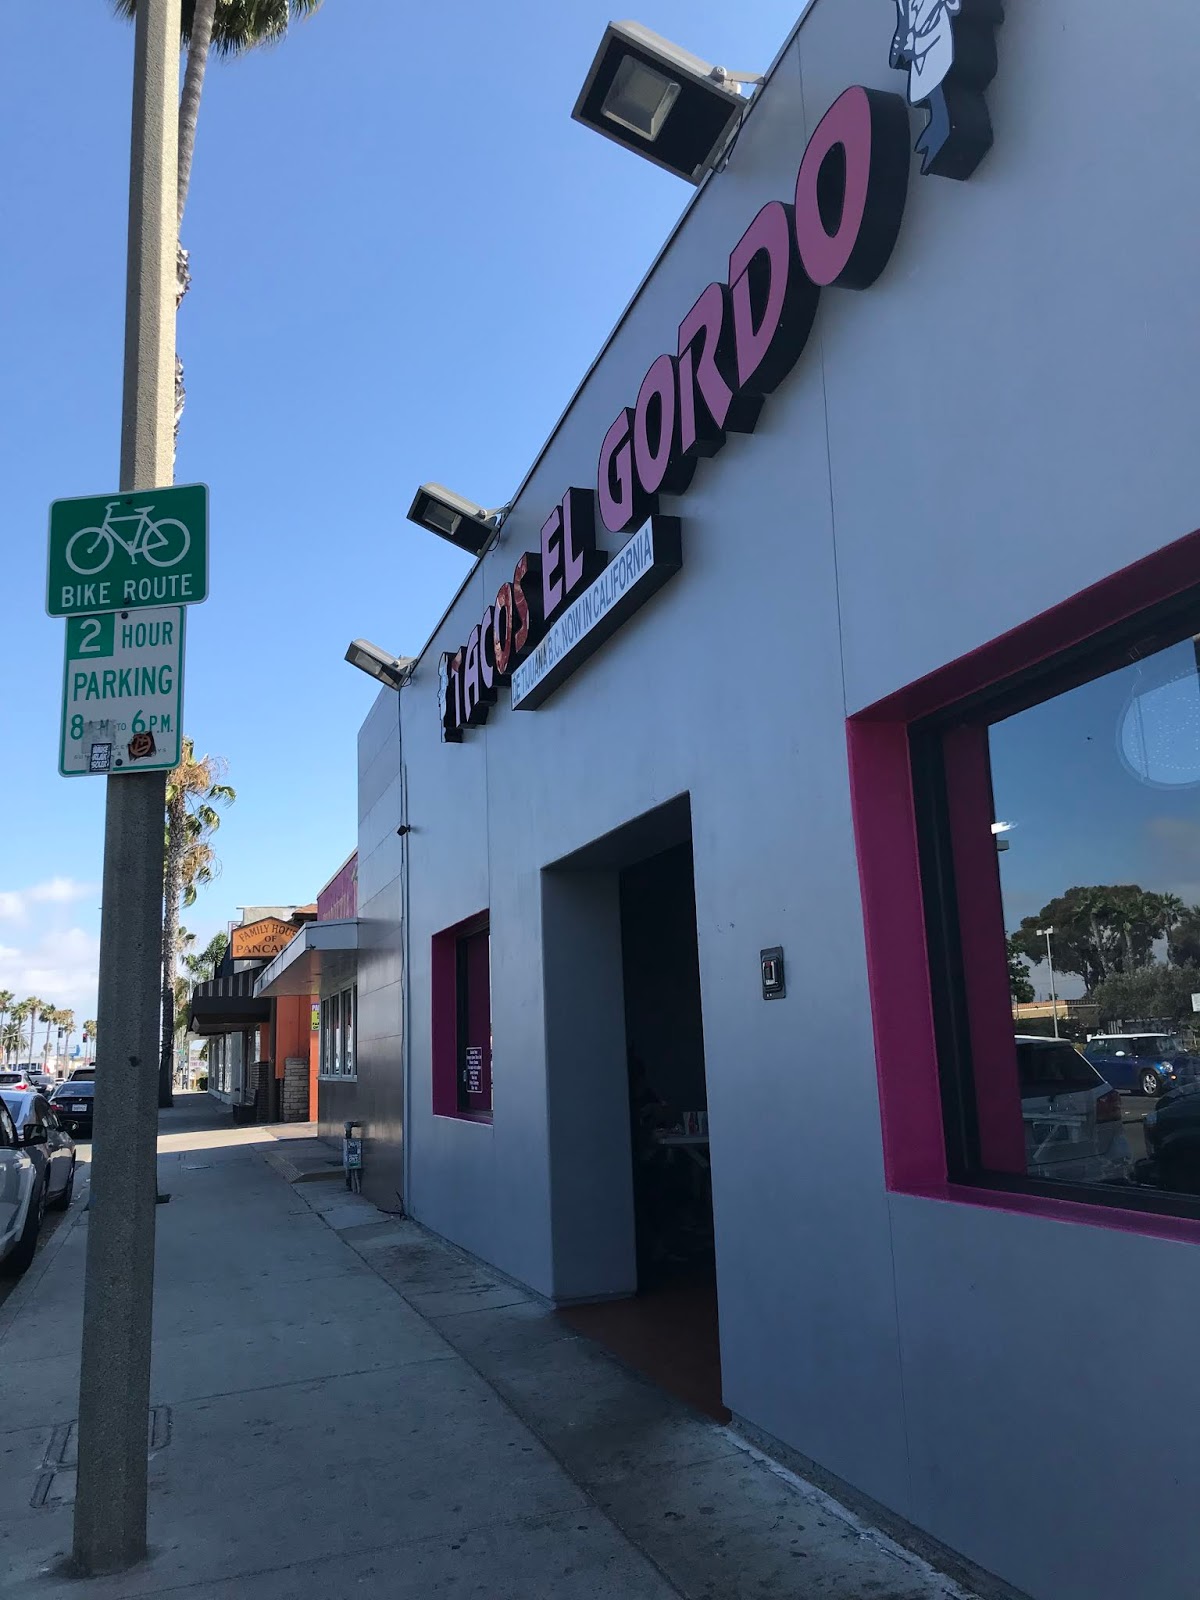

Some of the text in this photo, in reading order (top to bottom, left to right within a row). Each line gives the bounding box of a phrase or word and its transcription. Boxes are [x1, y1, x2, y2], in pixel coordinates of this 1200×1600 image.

[451, 85, 872, 728] TACOS EL GORDO
[61, 573, 193, 608] BIKE ROUTE
[513, 672, 521, 704] DE
[562, 603, 582, 651] NOW
[583, 595, 592, 629] IN
[594, 528, 652, 616] CALIFORNIA
[79, 618, 173, 654] 2 HOUR
[73, 664, 173, 702] PARKING
[70, 714, 84, 740] 8
[117, 722, 127, 731] TO
[132, 709, 146, 733] 6
[149, 714, 174, 734] P.M.
[239, 924, 270, 942] FAMILY
[271, 924, 297, 938] HOUS
